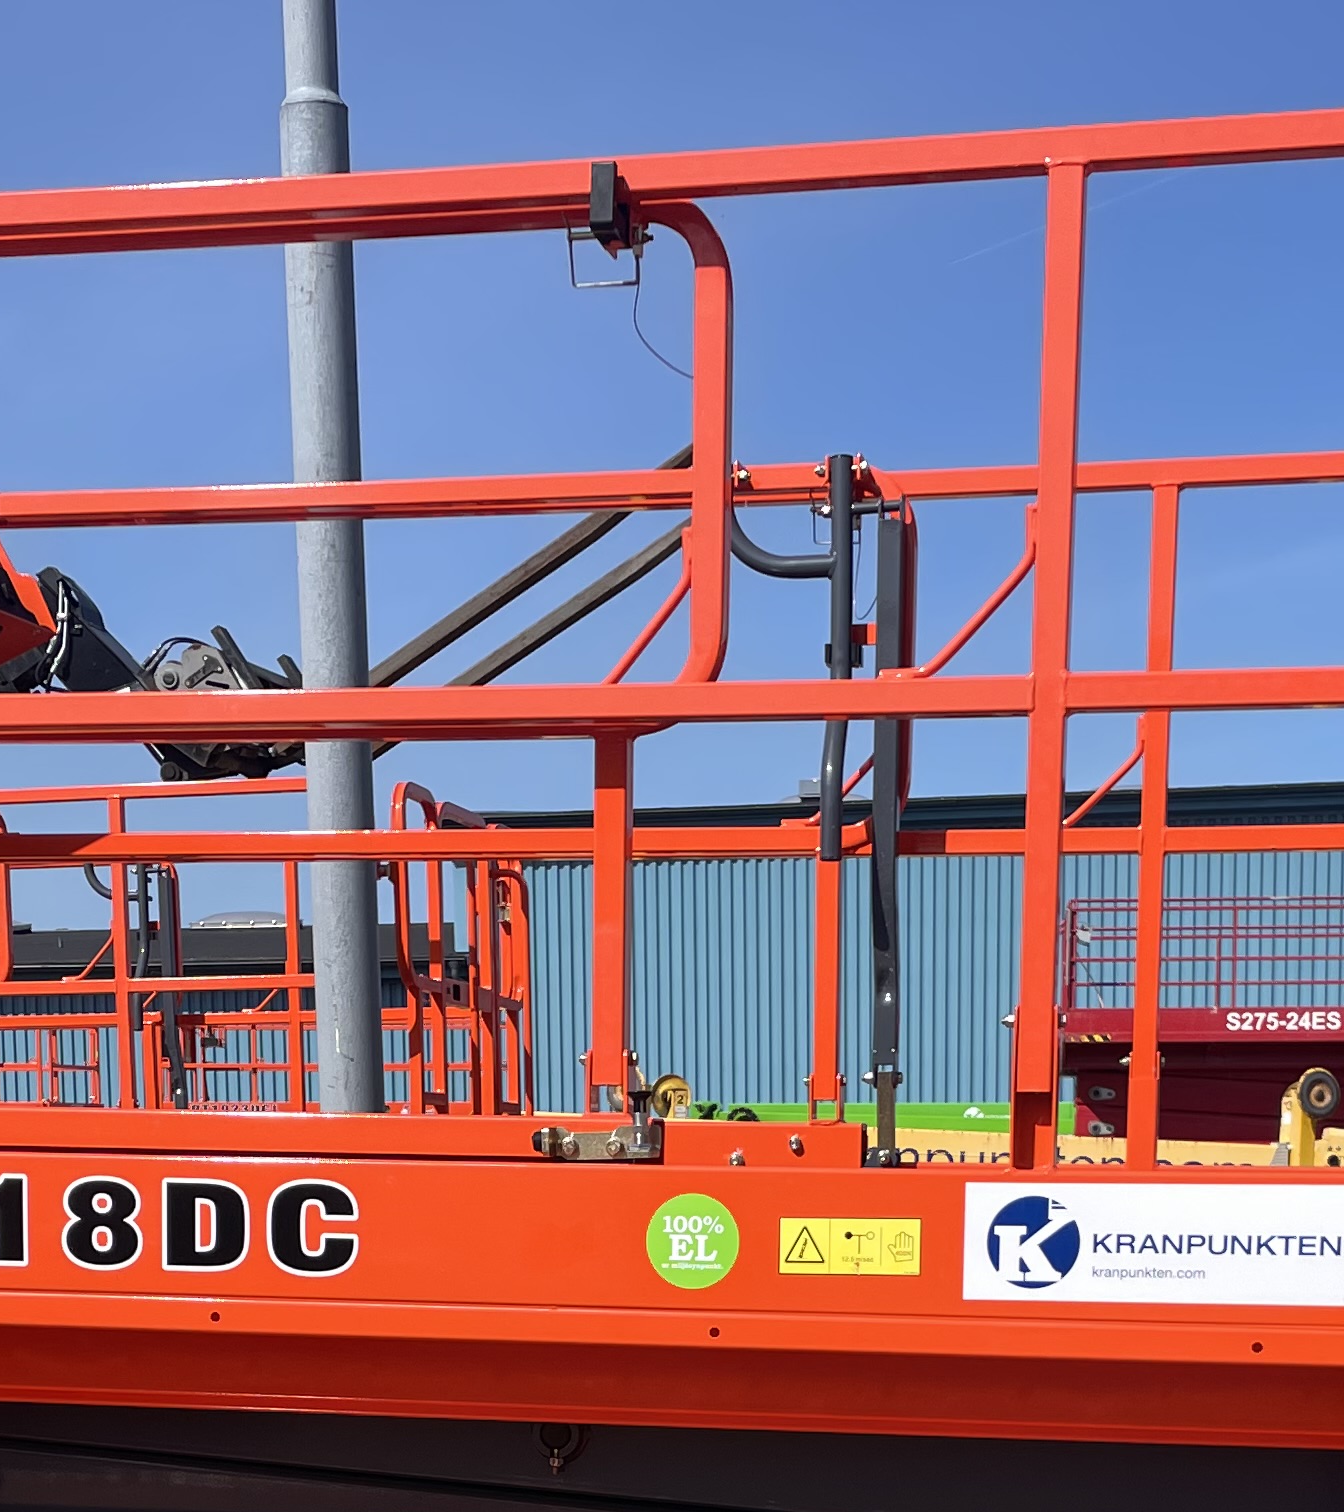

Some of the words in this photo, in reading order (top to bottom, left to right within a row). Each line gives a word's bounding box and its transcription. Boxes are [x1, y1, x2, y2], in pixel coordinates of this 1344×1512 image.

[1226, 1012, 1342, 1031] S275-24ES
[662, 1215, 725, 1234] 100%
[668, 1234, 718, 1262] EL
[1092, 1233, 1342, 1257] KRANPUNKTEN
[1091, 1266, 1206, 1281] kranpunkten.com
